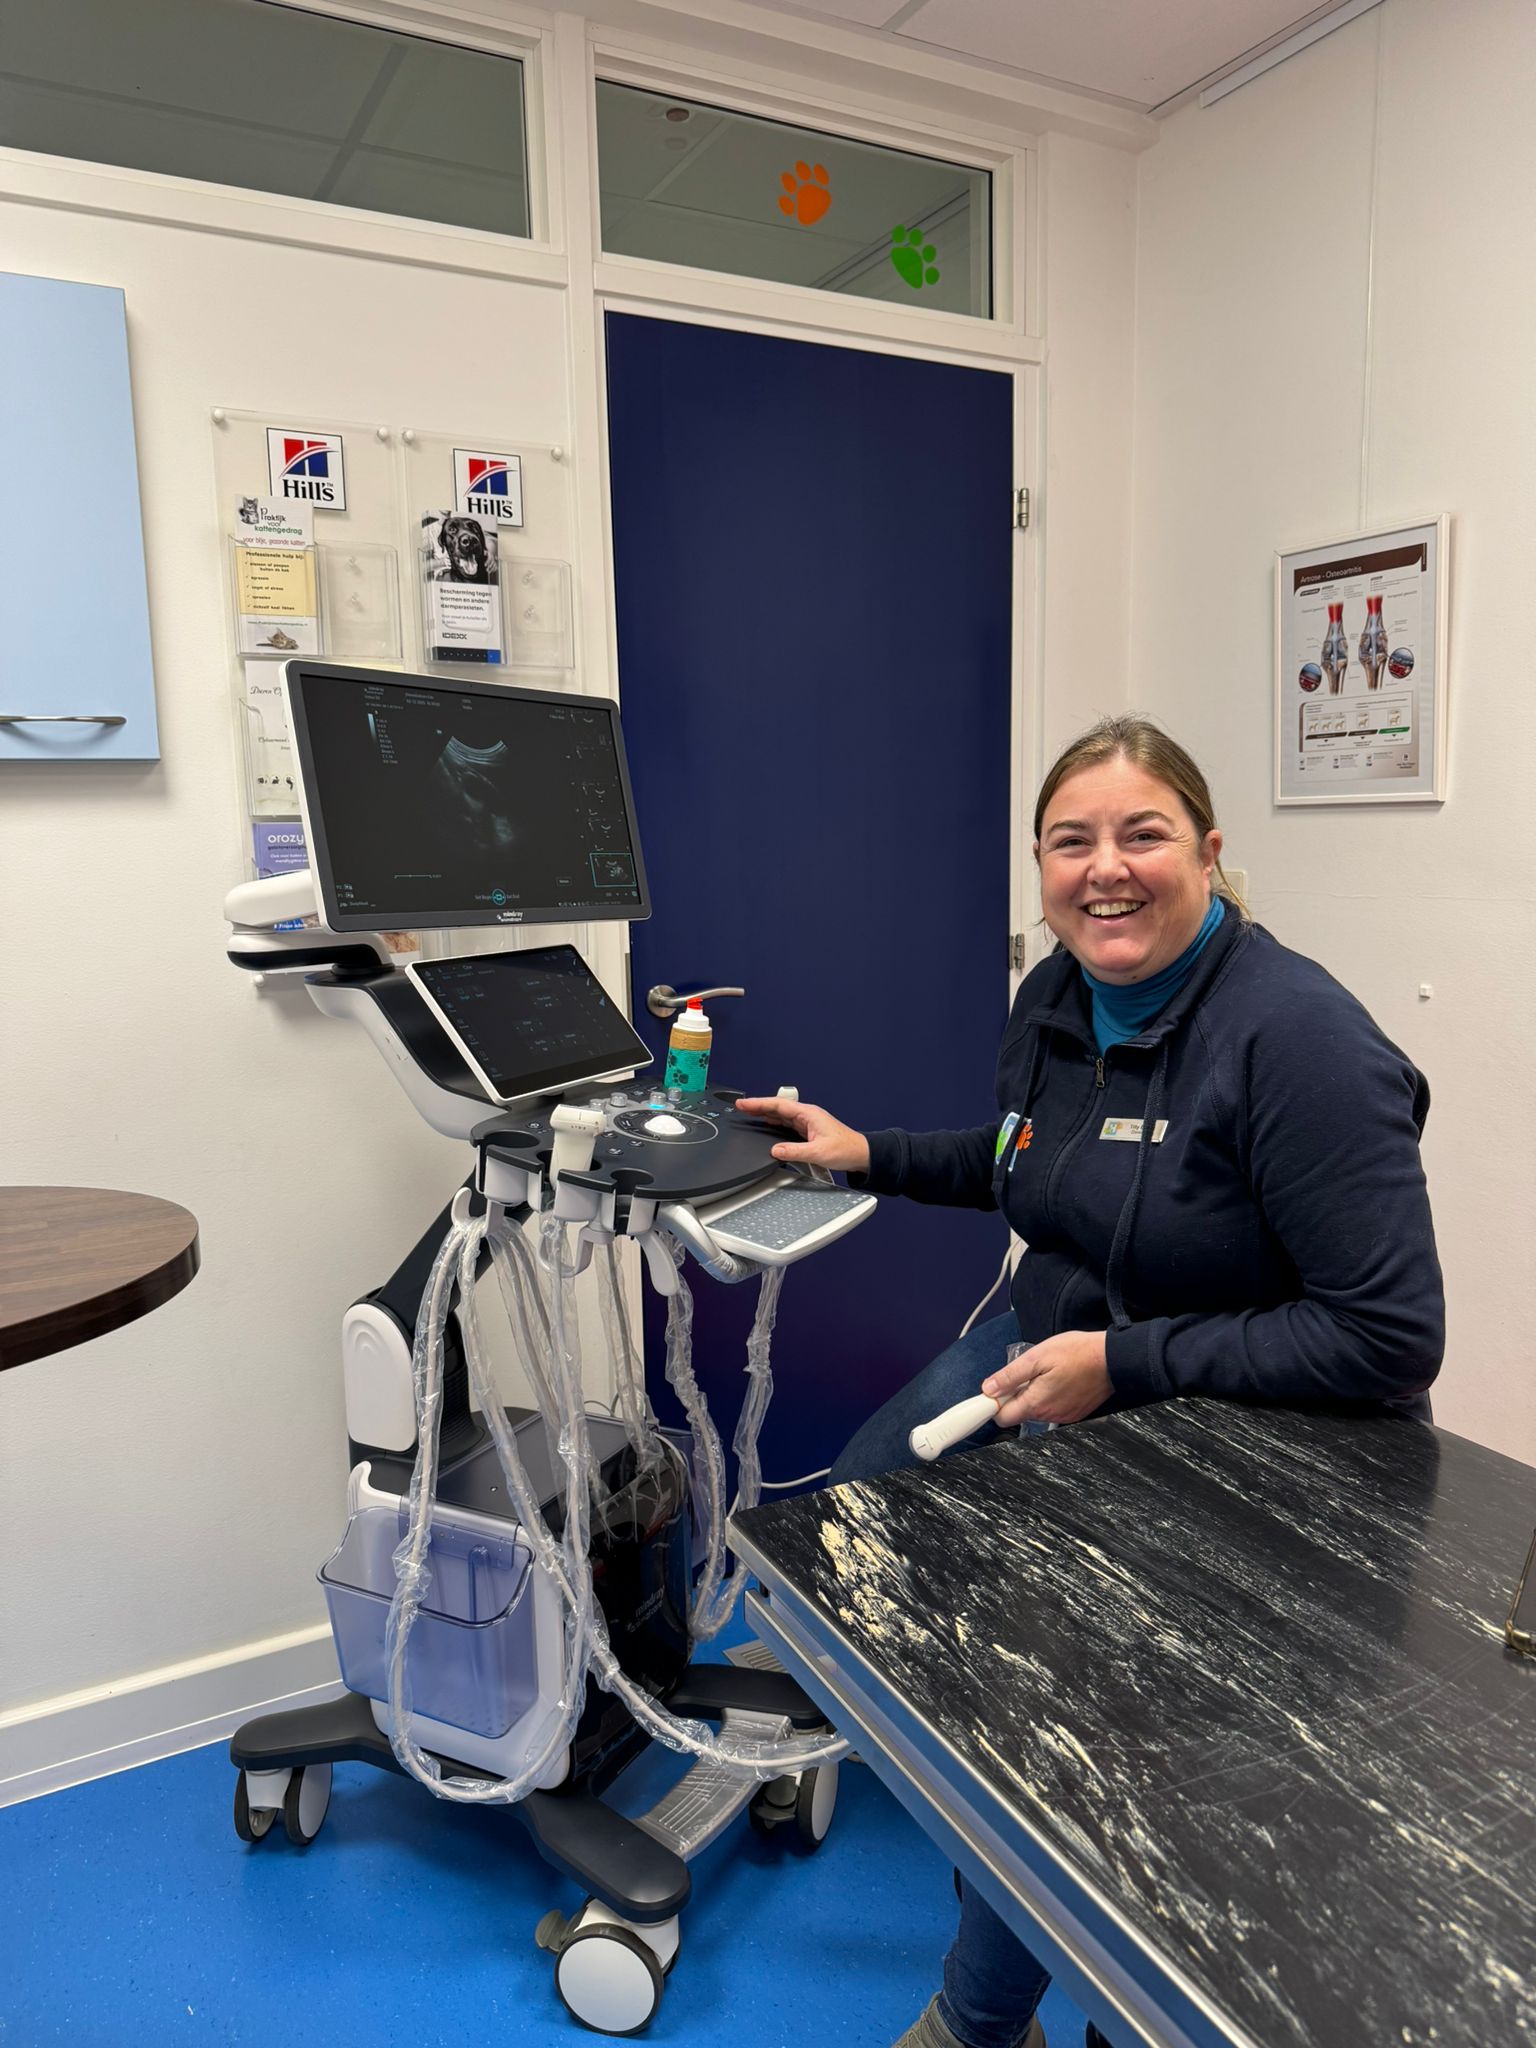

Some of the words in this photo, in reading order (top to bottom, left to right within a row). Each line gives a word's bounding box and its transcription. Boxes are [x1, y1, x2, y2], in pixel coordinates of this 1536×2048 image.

[282, 479, 334, 501] Hill's
[467, 497, 513, 518] Hill's
[260, 507, 286, 522] Praktijk
[255, 525, 303, 536] kattengedrag
[1301, 574, 1321, 583] Artrose
[1325, 566, 1362, 579] Osteoartritis
[440, 588, 476, 597] Bescherming
[440, 604, 484, 612] darmparasieten.
[442, 632, 467, 640] IDEXX
[267, 835, 304, 846] orozy
